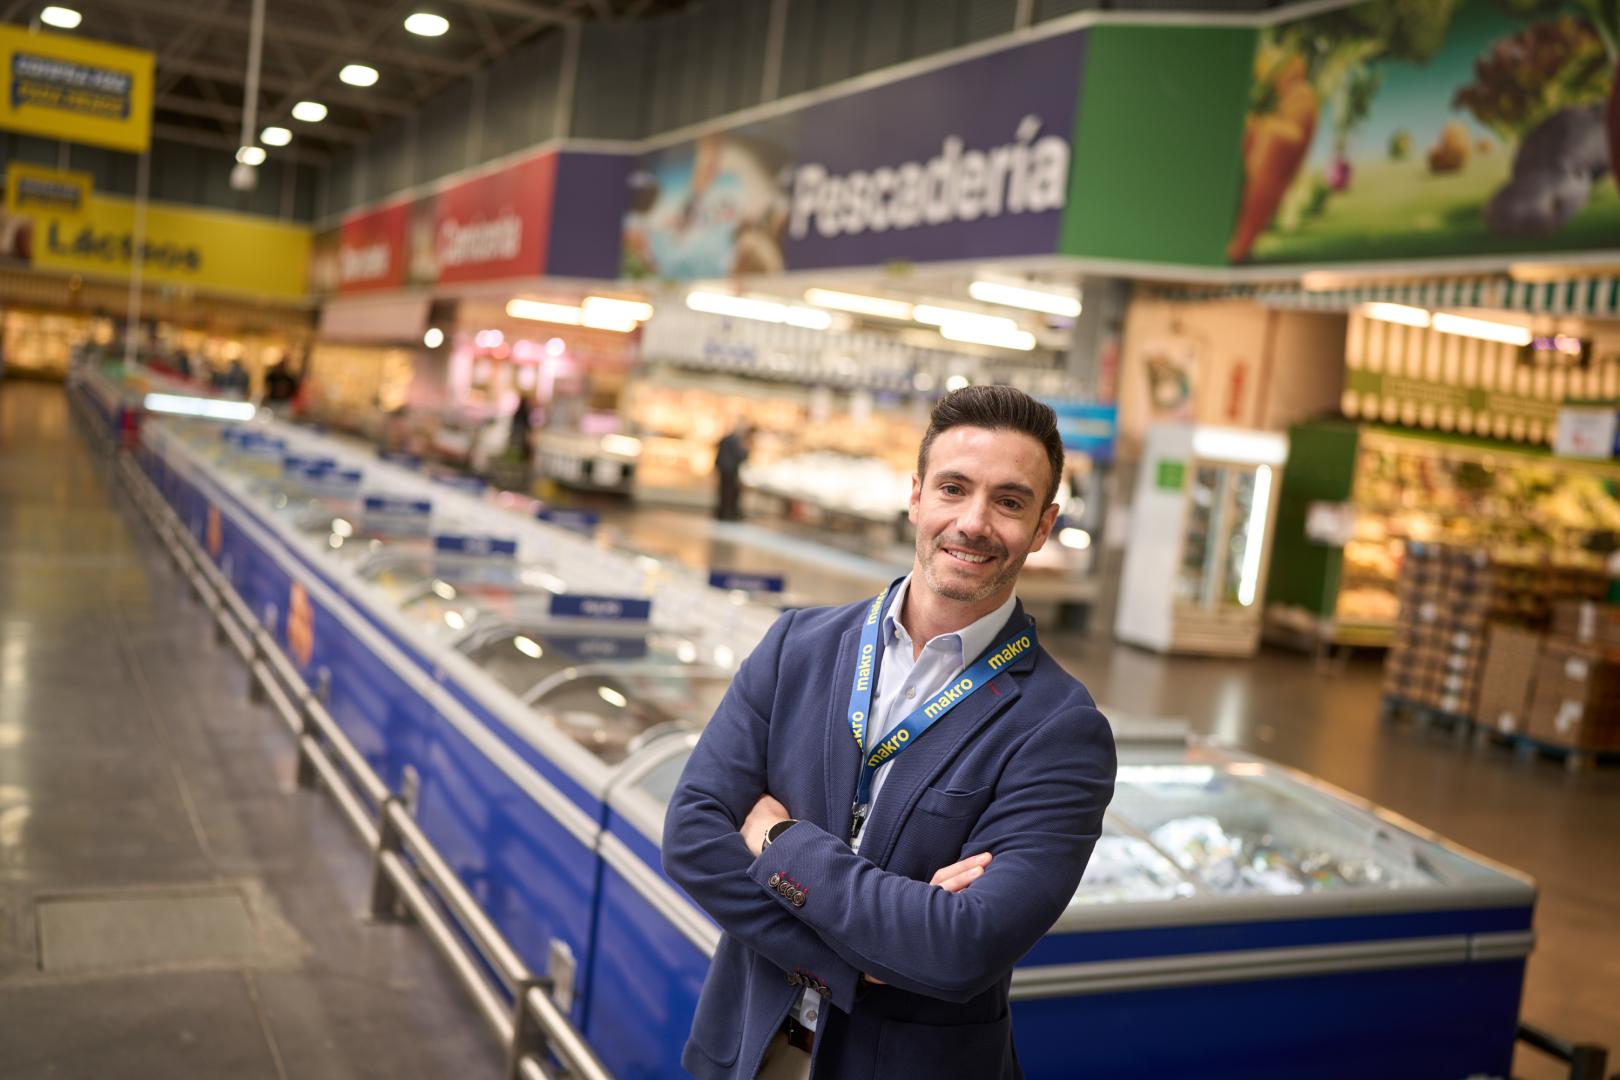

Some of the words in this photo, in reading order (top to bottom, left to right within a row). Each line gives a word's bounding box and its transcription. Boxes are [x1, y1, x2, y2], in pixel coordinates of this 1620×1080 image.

[790, 115, 1069, 239] Pescadería
[857, 644, 873, 691] makro
[988, 635, 1031, 669] makro
[924, 678, 973, 718] makro
[852, 711, 864, 752] kro
[868, 729, 910, 767] makro
